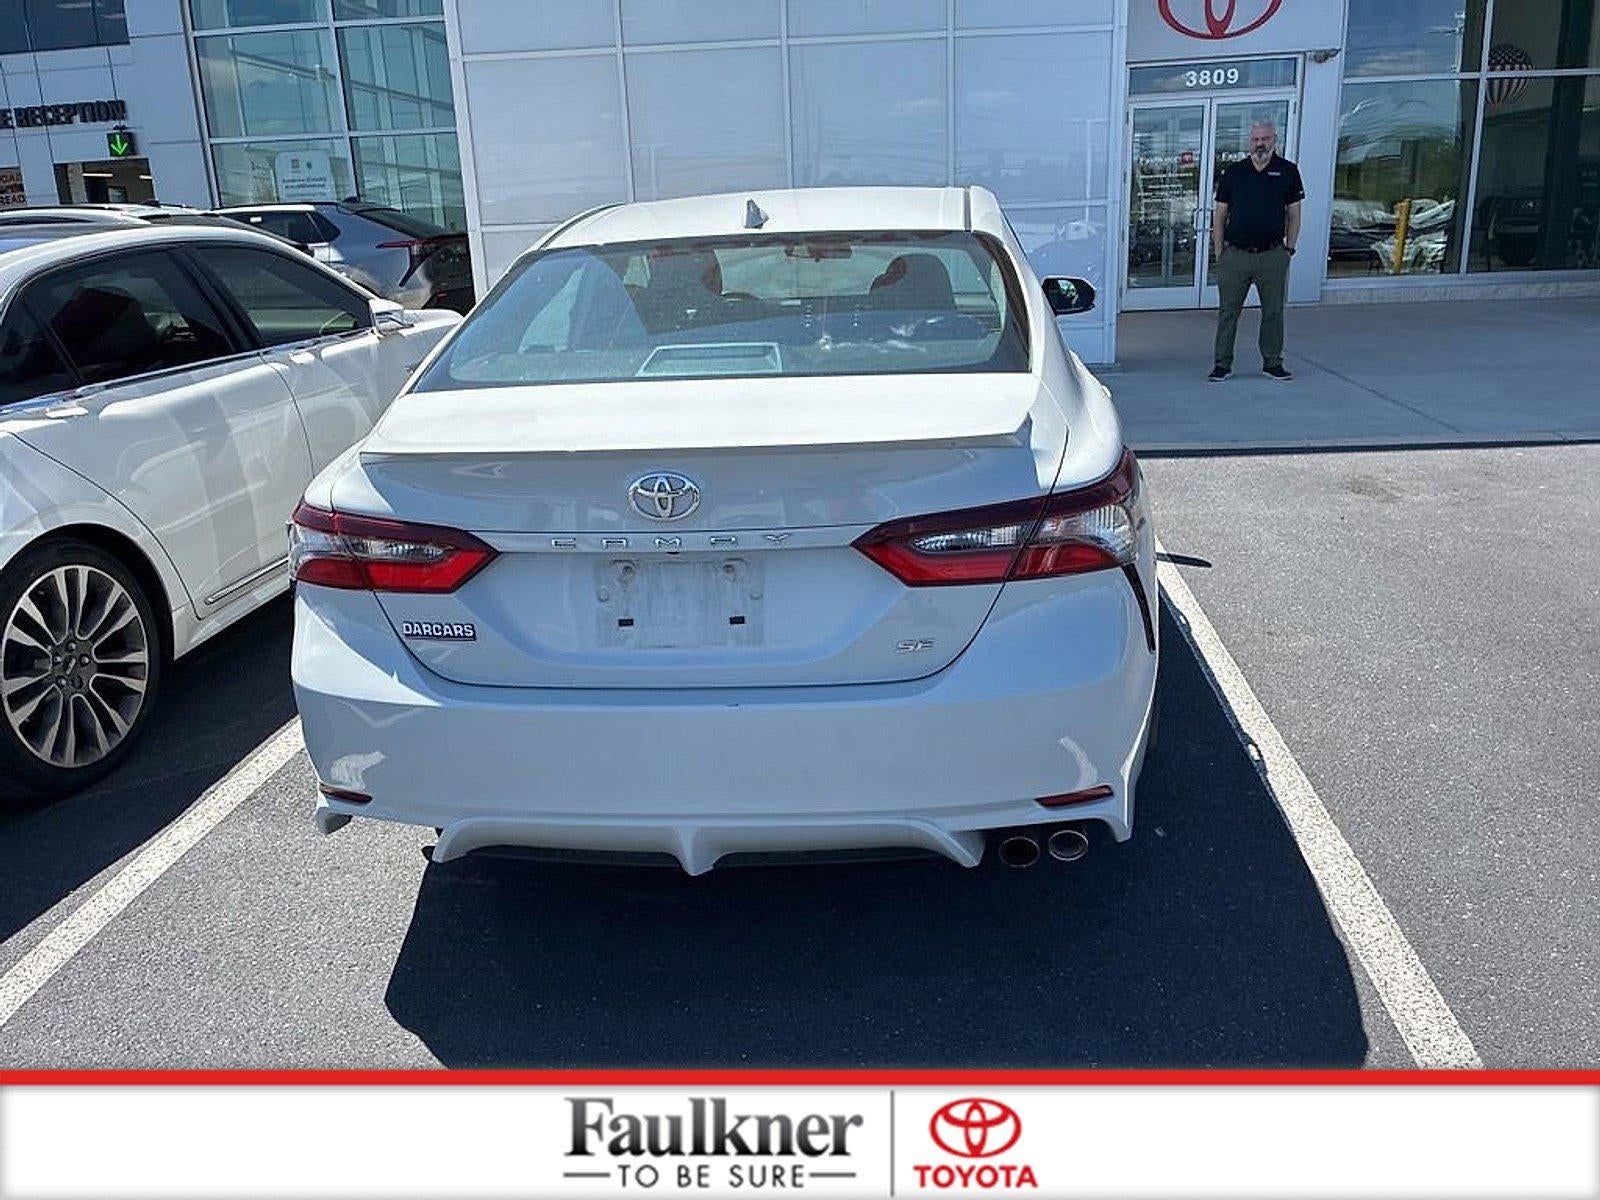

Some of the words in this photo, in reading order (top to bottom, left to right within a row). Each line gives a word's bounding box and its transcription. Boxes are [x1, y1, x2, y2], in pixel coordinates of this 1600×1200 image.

[1185, 68, 1239, 87] 3809
[13, 100, 126, 127] RECEPTION
[551, 533, 792, 550] CAMRY
[402, 622, 476, 637] DARCARS
[895, 638, 938, 653] SE
